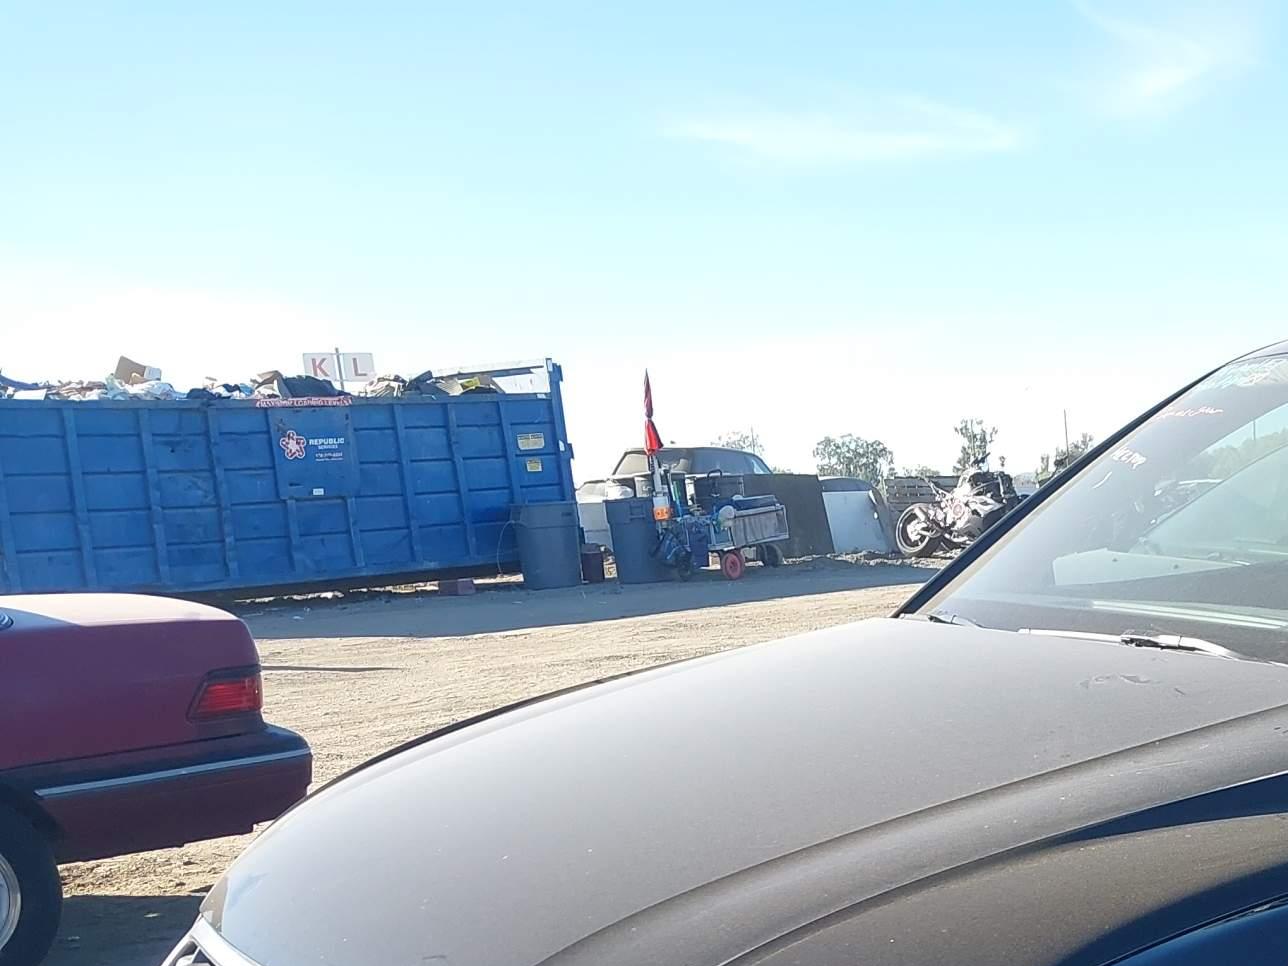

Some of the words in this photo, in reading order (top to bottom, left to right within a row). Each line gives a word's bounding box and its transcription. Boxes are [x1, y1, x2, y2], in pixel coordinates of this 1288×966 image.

[311, 357, 330, 377] K
[352, 357, 368, 377] L
[308, 437, 345, 446] REPUBLIC
